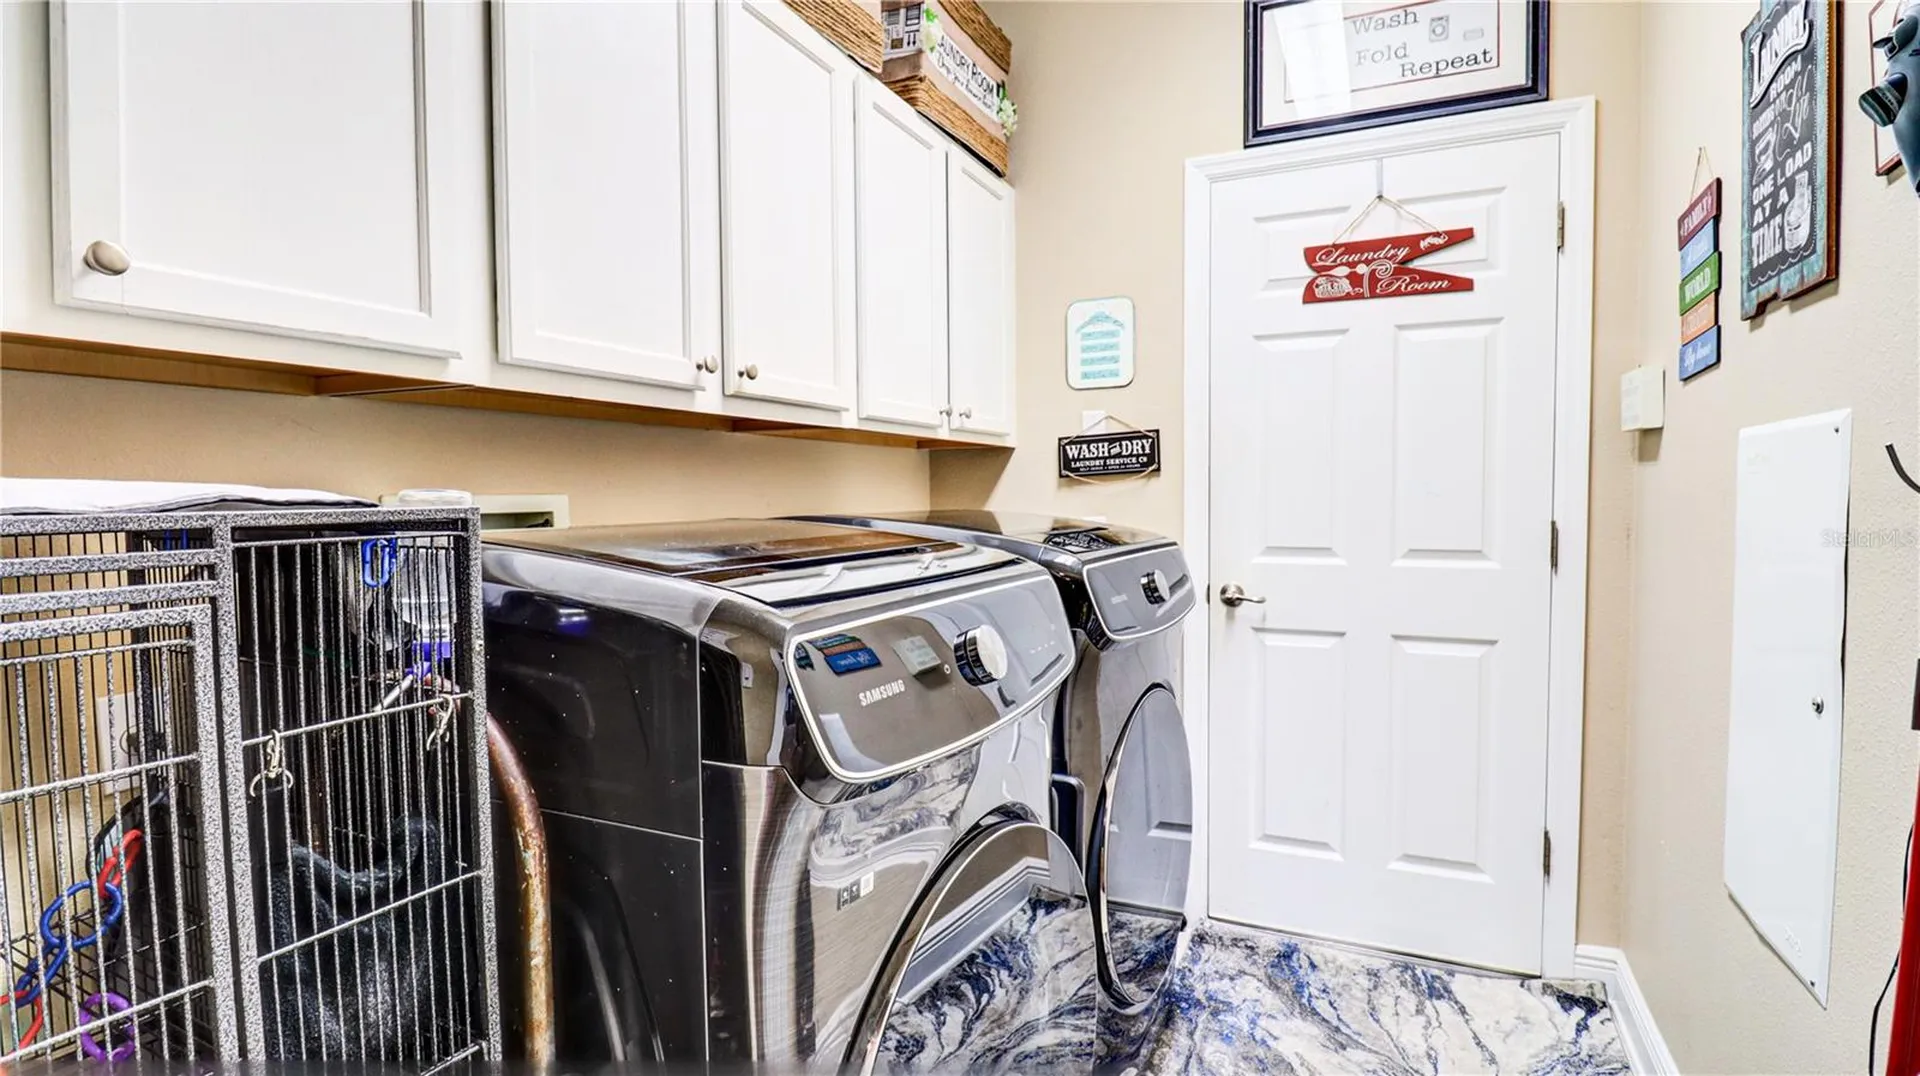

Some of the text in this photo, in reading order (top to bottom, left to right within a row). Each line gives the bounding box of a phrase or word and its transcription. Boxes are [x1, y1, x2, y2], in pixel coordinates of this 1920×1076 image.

[1352, 9, 1420, 35] Wash
[1355, 42, 1408, 67] Fold
[1400, 47, 1493, 78] Repeat
[1770, 53, 1801, 102] ROOM
[1752, 141, 1811, 206] ONE LOAD
[1752, 186, 1789, 228] AT A
[1752, 213, 1782, 269] TIME
[1311, 244, 1410, 266] Laundry
[1376, 275, 1451, 294] Room
[1066, 442, 1109, 459] WASH
[1121, 439, 1152, 456] DRY
[1071, 459, 1104, 468] LAUNDRY
[1106, 457, 1137, 465] SERVICE
[859, 679, 905, 707] SAMSUNG
